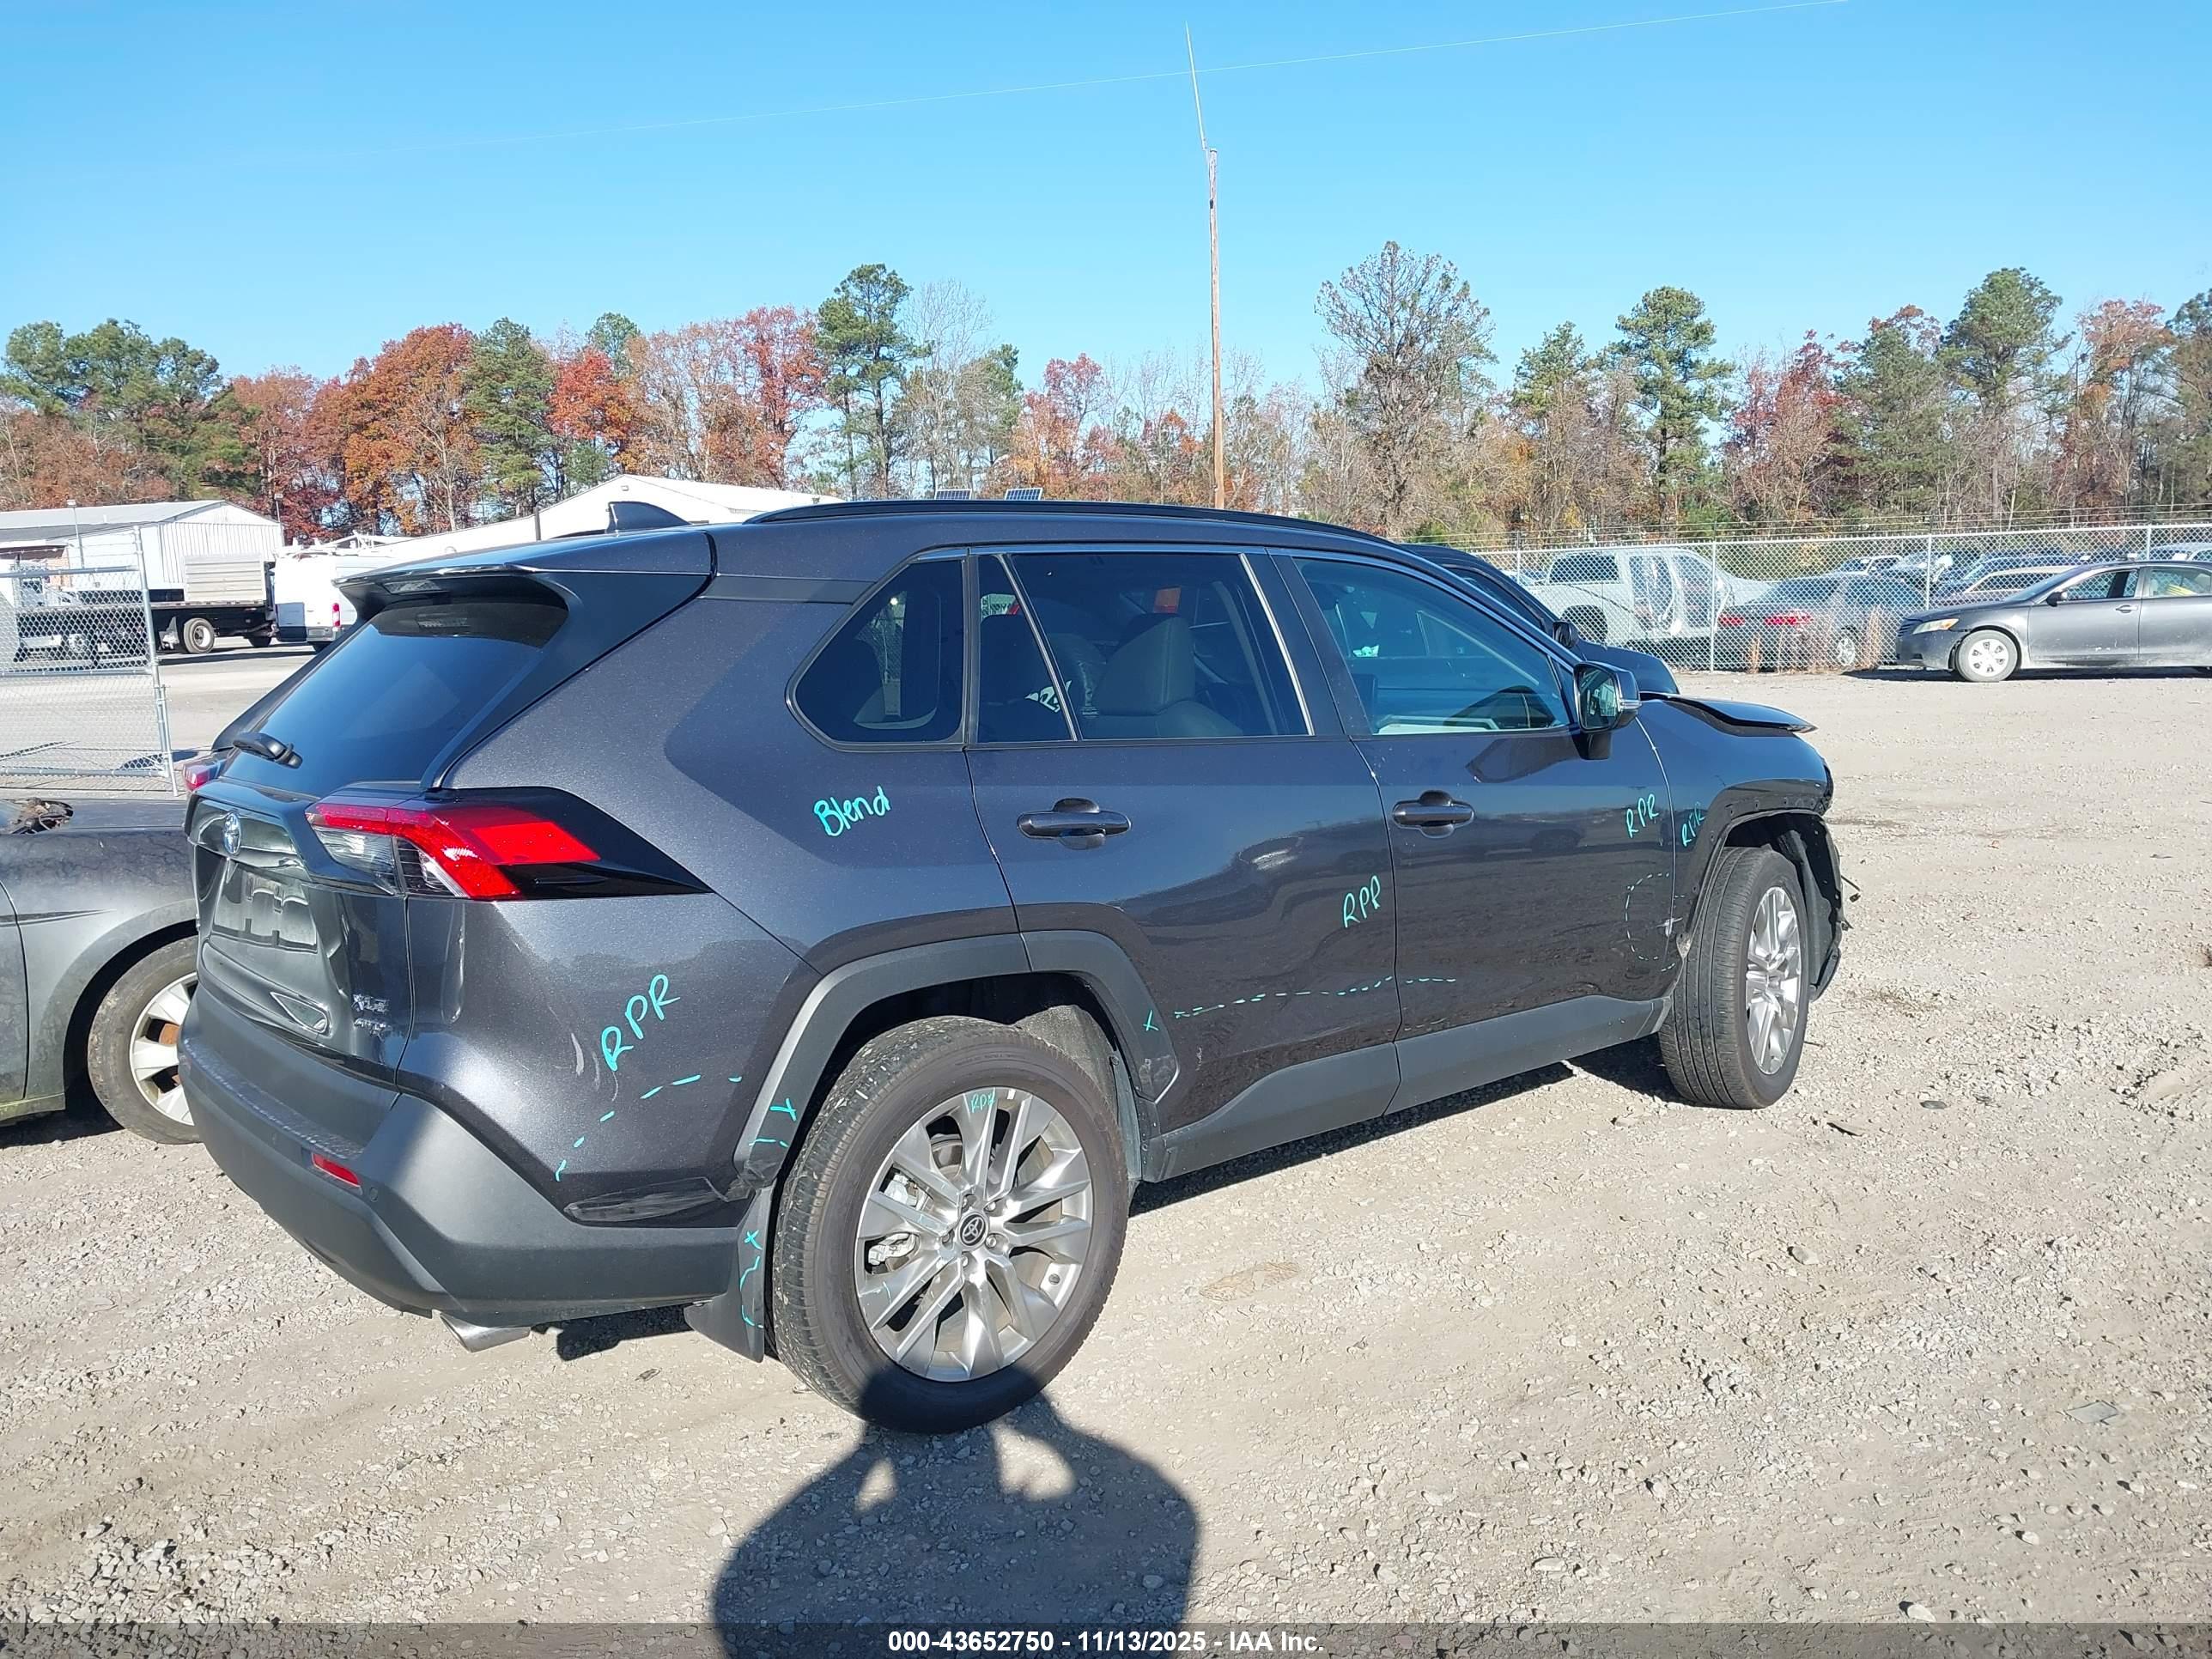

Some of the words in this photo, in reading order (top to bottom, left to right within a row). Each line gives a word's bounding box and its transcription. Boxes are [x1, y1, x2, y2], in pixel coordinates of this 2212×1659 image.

[813, 785, 891, 837] Blend
[1626, 793, 1660, 839] RPR
[601, 974, 681, 1072] RPR
